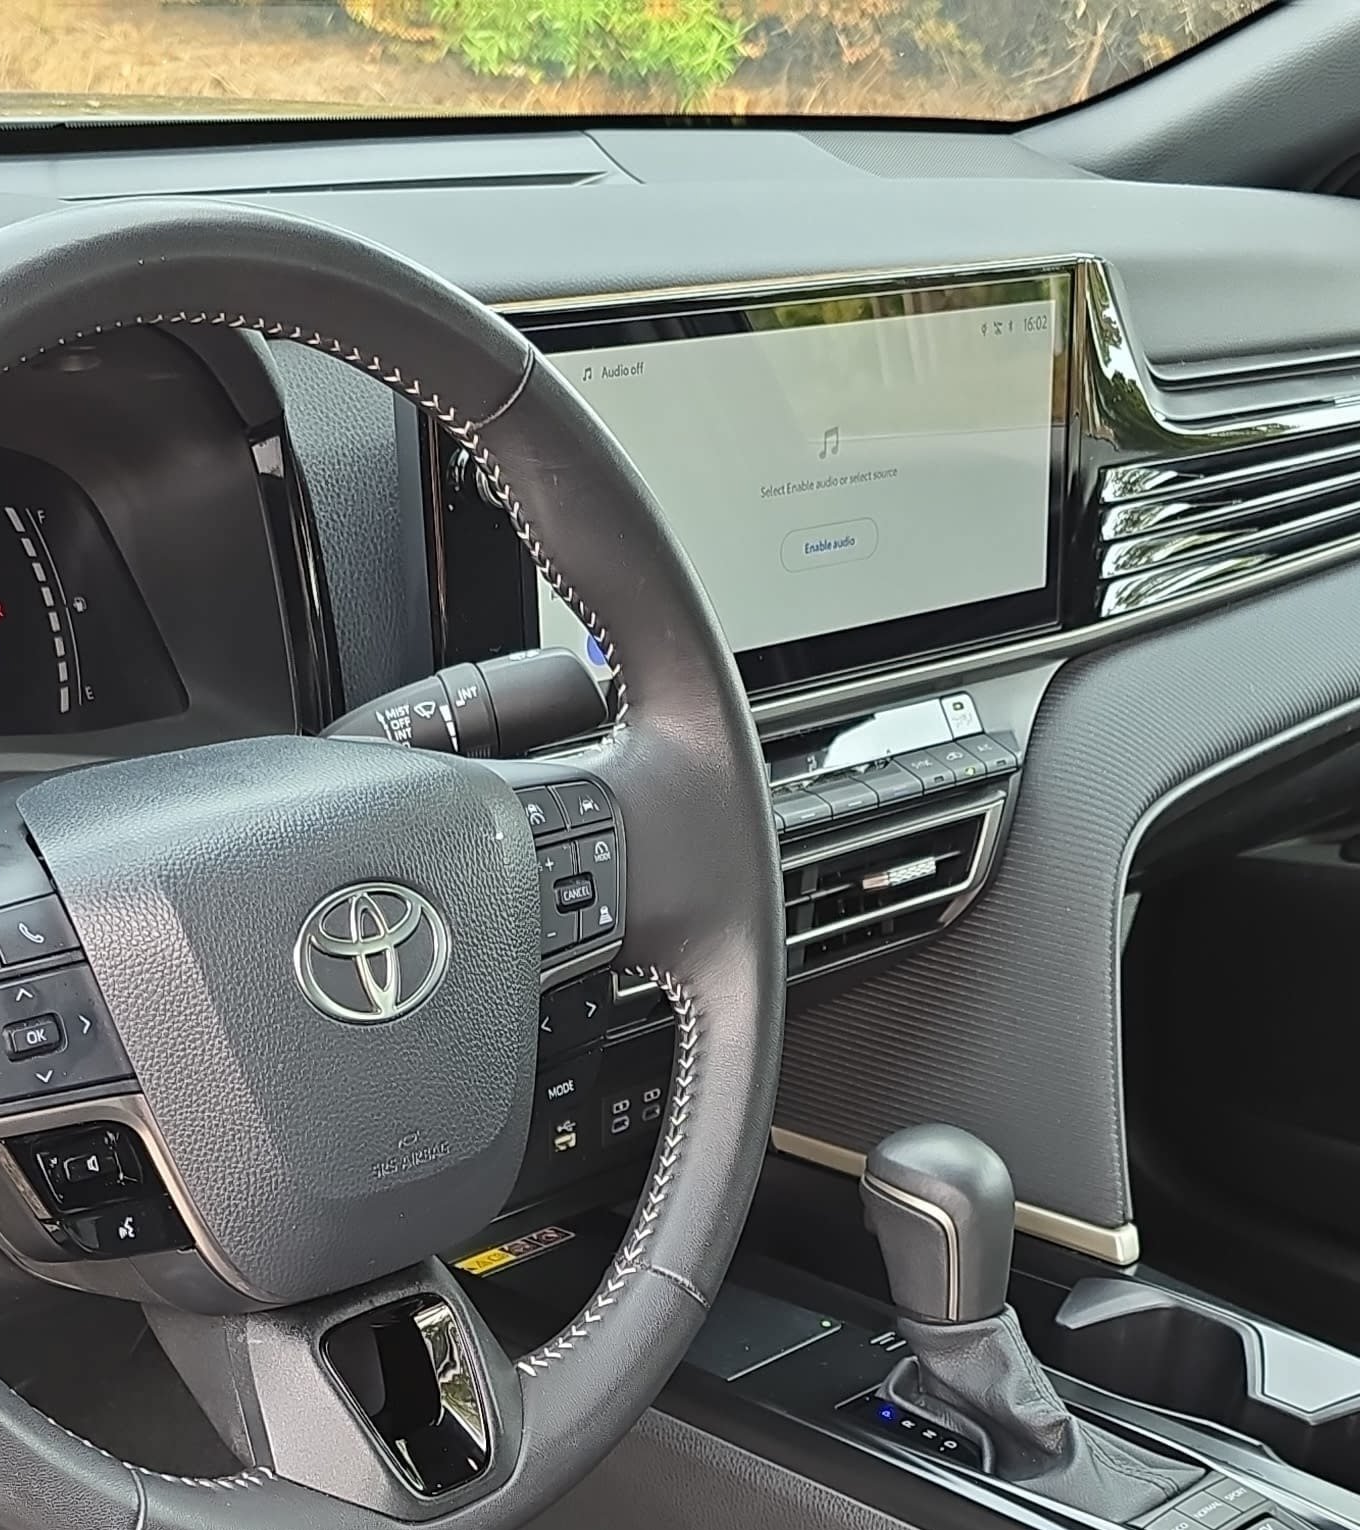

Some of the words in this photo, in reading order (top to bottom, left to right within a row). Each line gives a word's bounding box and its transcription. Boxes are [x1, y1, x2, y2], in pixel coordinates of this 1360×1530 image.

[1024, 314, 1048, 332] 16:02
[601, 364, 629, 379] Audio
[630, 361, 644, 376] off
[760, 484, 786, 498] Select
[786, 479, 815, 495] Enable
[816, 475, 838, 490] audio
[839, 475, 848, 486] or
[849, 470, 872, 484] select
[873, 467, 897, 481] source
[37, 509, 46, 524] F
[804, 538, 832, 554] Enable
[833, 535, 856, 549] audio
[85, 686, 94, 701] E
[458, 686, 478, 701] INT
[384, 704, 411, 720] MIST
[390, 716, 412, 730] OFF
[394, 727, 412, 741] INT
[563, 885, 591, 902] CANCEL
[26, 1028, 48, 1045] OK
[548, 1079, 575, 1100] MODE
[901, 1420, 916, 1429] R
[922, 1429, 937, 1439] N
[944, 1440, 958, 1449] D
